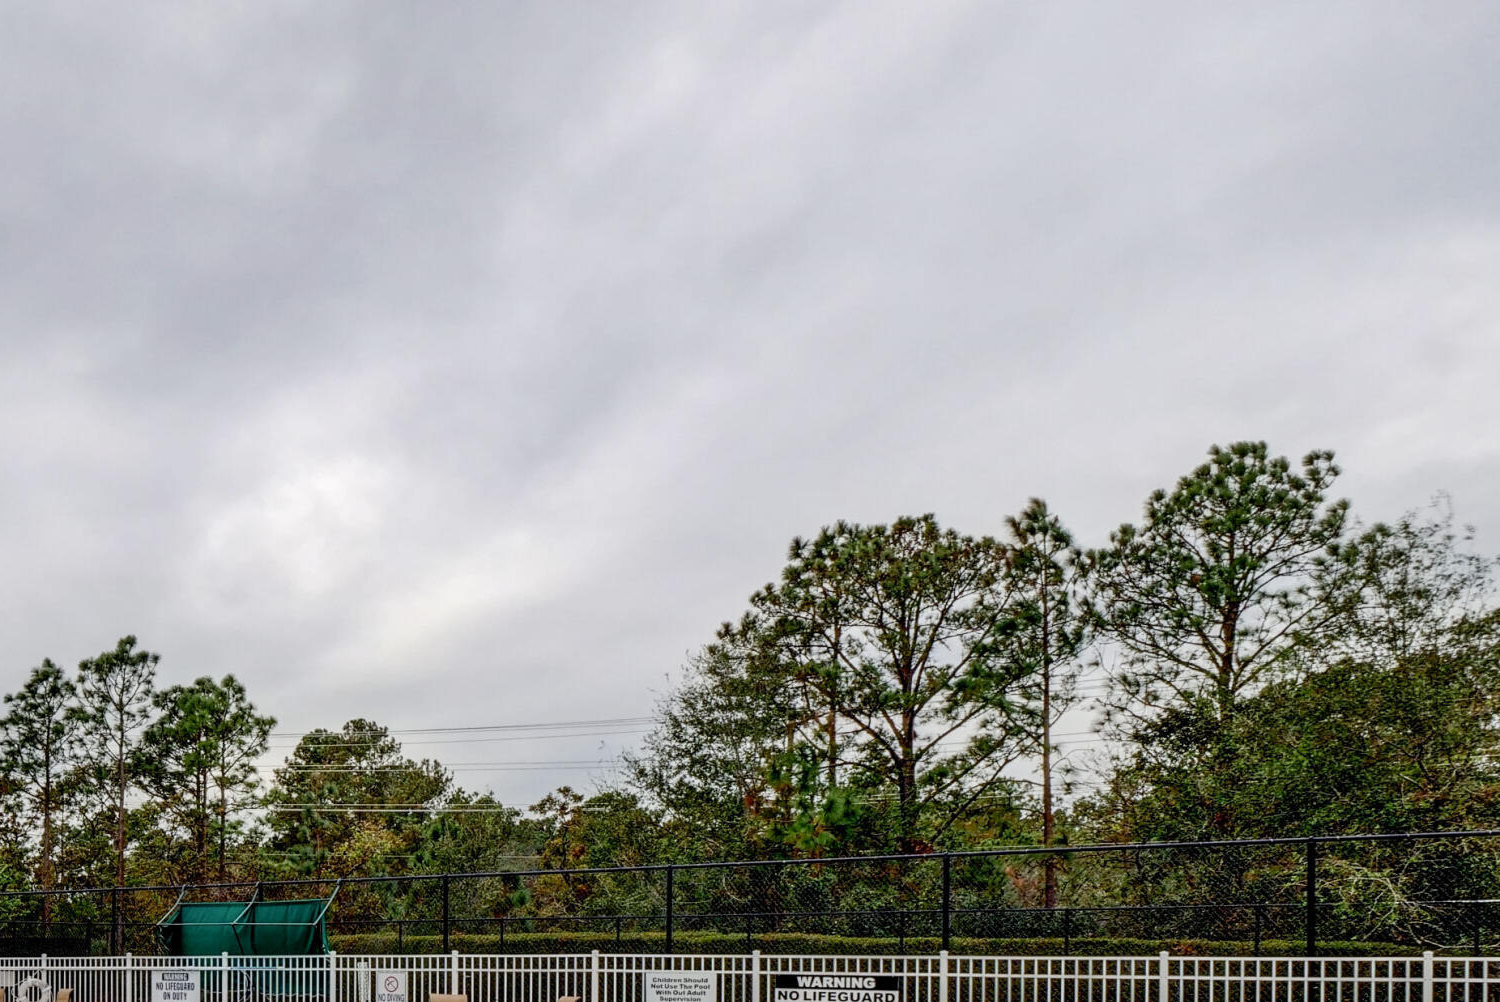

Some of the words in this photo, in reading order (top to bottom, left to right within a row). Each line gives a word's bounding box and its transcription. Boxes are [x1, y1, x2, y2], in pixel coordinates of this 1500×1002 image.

[156, 982, 164, 990] NO
[165, 982, 195, 990] LIFEGUARD
[796, 976, 876, 989] WARNING
[163, 992, 171, 1000] ON
[172, 992, 187, 1000] DUTY
[377, 993, 386, 1002] NO
[387, 993, 405, 1002] DIVING
[778, 990, 799, 1000] NO
[803, 991, 895, 1002] LIFEGUARD
